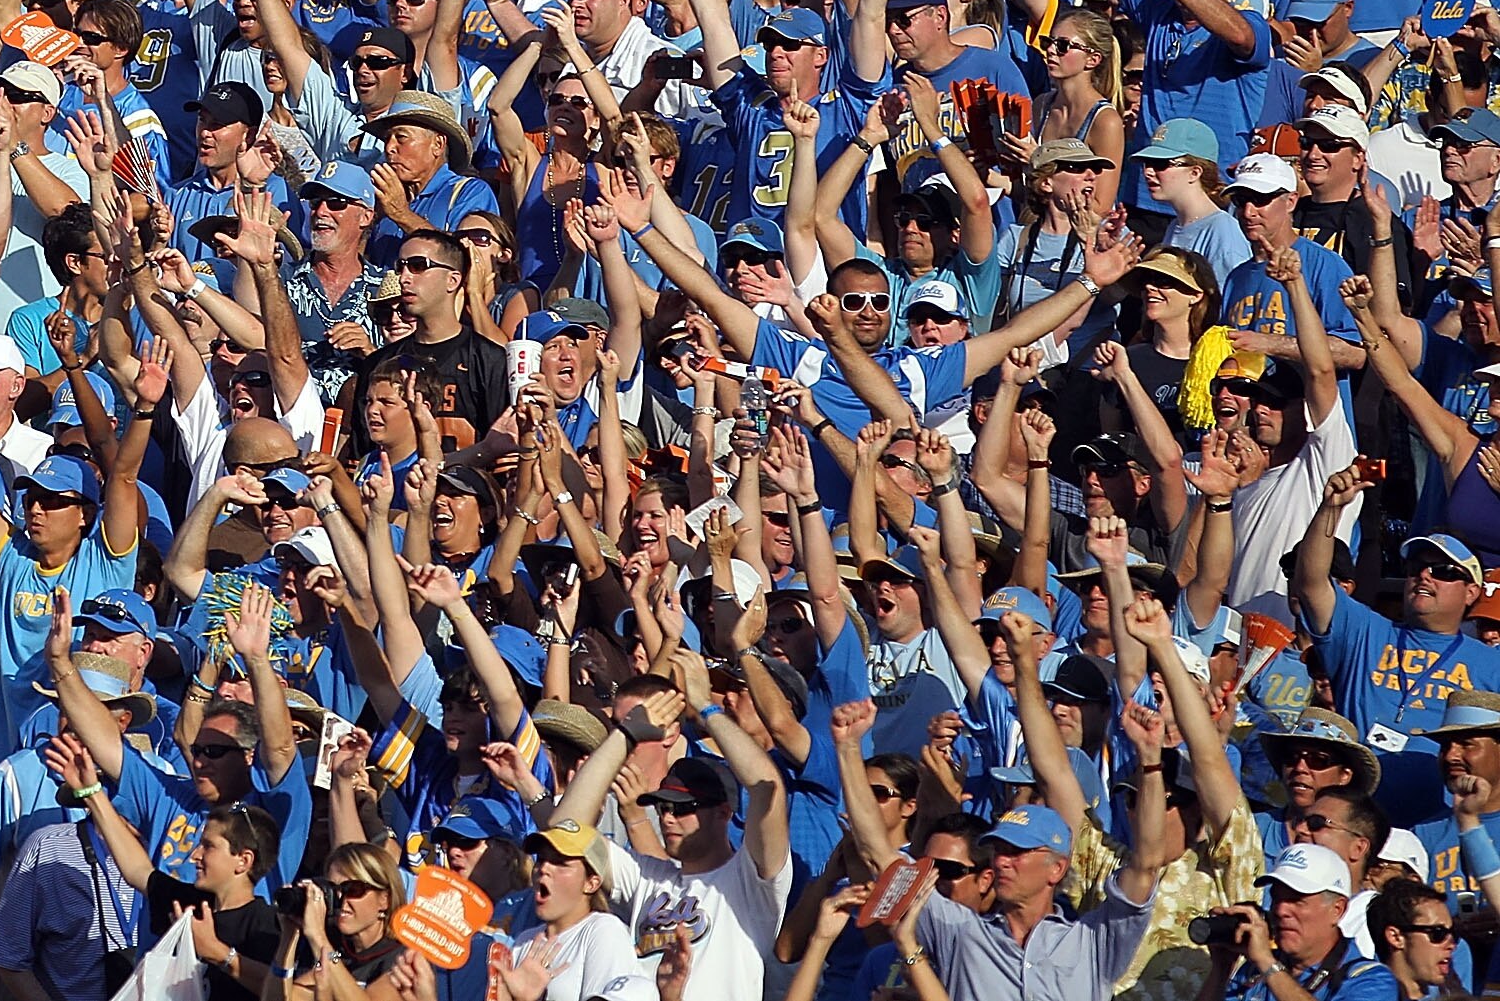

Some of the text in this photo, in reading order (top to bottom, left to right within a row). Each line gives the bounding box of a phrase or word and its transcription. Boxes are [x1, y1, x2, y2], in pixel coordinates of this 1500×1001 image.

[1431, 0, 1465, 20] Ucla
[130, 28, 174, 90] 9
[321, 161, 337, 178] B
[752, 130, 793, 206] 3
[913, 285, 944, 301] Ucla
[1377, 645, 1473, 690] UCLA
[1277, 849, 1309, 868] Ucla
